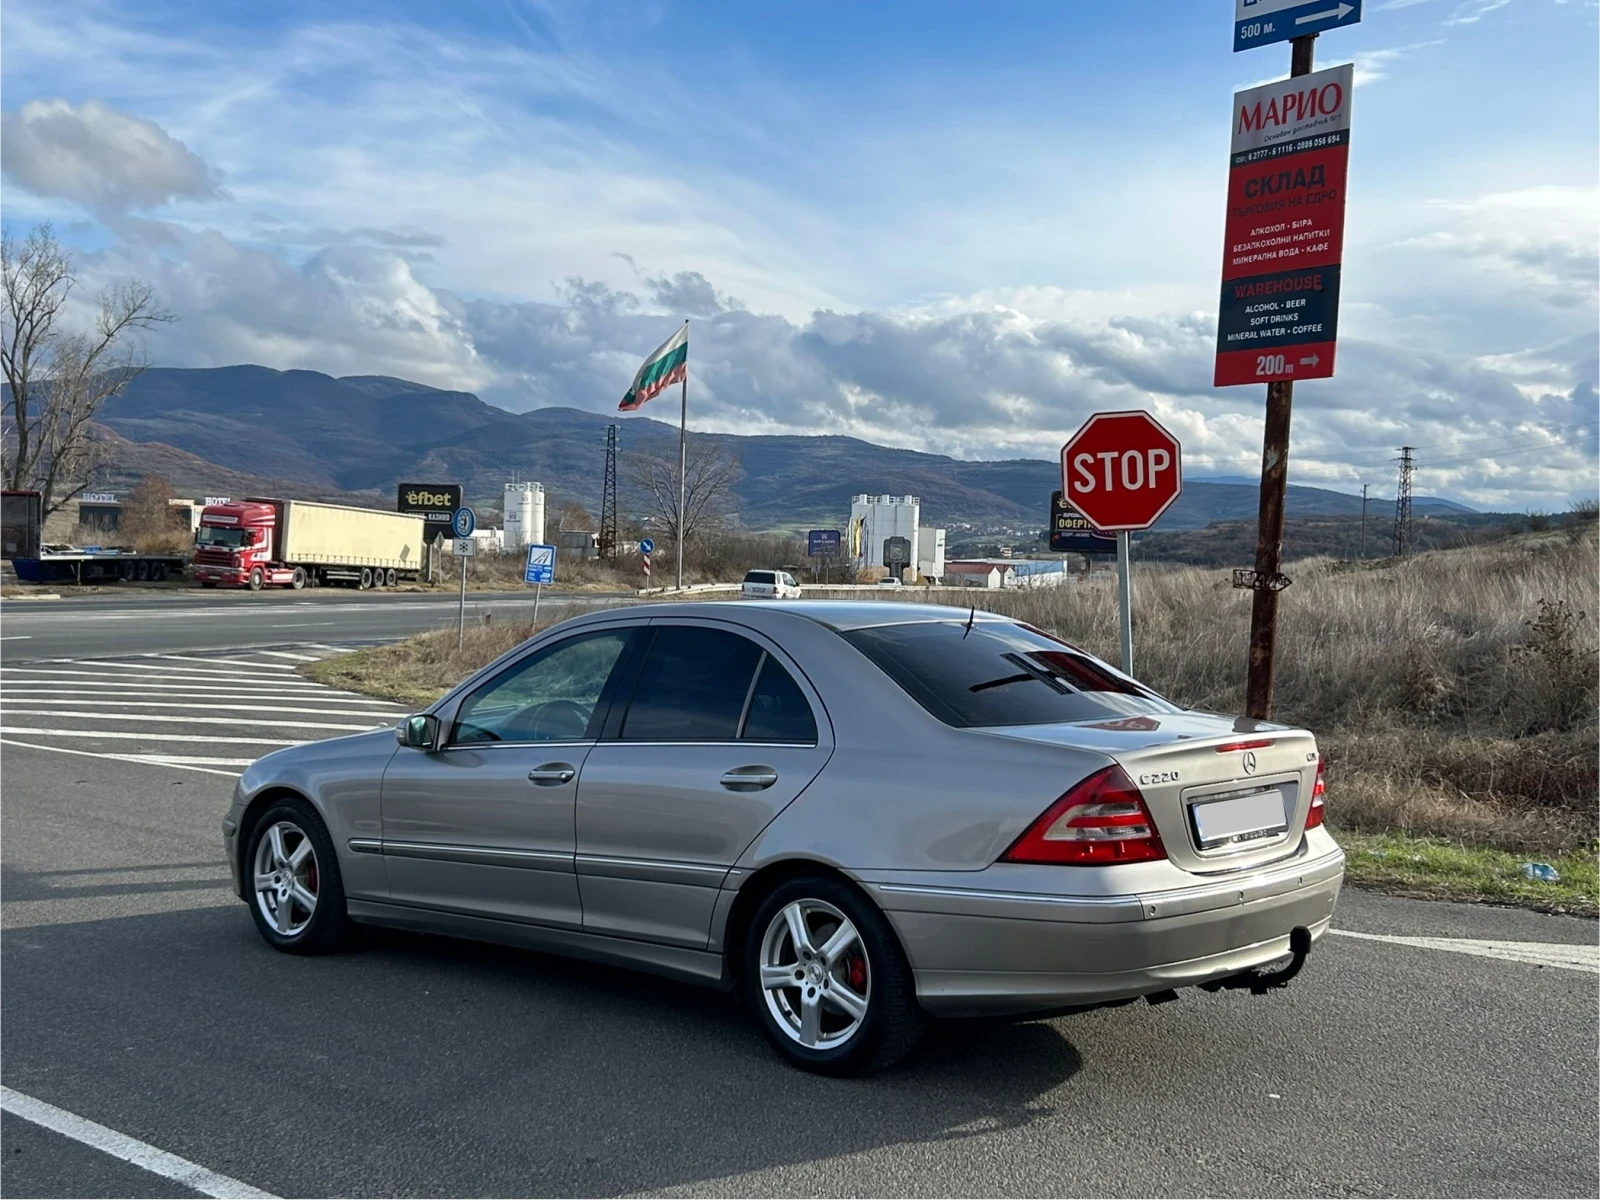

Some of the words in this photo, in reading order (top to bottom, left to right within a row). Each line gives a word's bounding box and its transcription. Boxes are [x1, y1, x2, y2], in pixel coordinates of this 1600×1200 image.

[1241, 23, 1260, 39] 500
[1238, 83, 1343, 135] МАРИО
[1253, 149, 1268, 160] 2777
[1278, 144, 1293, 154] 1116
[1297, 140, 1313, 150] 0886
[1314, 137, 1326, 147] 056
[1327, 134, 1340, 144] 694
[1244, 164, 1326, 198] СКЛАД
[1232, 199, 1285, 219] ТЪРГОВИЯ
[1288, 195, 1302, 208] НА
[1306, 189, 1337, 205] ЕДРО
[1250, 223, 1285, 236] АЛКОХОЛ
[1292, 219, 1312, 229] БИРА
[1233, 235, 1291, 253] БЕЗАЛКОХОЛНИ
[1293, 229, 1330, 242] НАПИТКИ
[1233, 251, 1277, 265] МИНЕРАЛНА
[1278, 247, 1299, 257] ВОДА
[1306, 242, 1329, 253] КАФЕ
[1235, 275, 1322, 298] WAREHOUSE
[1245, 303, 1279, 313] ALCOHOL
[1286, 299, 1306, 308] BEER
[1250, 316, 1268, 326] SOFT
[1270, 313, 1299, 323] DRINKS
[1227, 331, 1258, 341] MINERAL
[1260, 328, 1286, 338] WATER
[1292, 323, 1323, 335] COFFEE
[1256, 355, 1285, 376] 200
[1285, 363, 1294, 374] m
[1073, 448, 1170, 494] STOP
[83, 493, 117, 503] HOTEL
[406, 491, 451, 506] efbet
